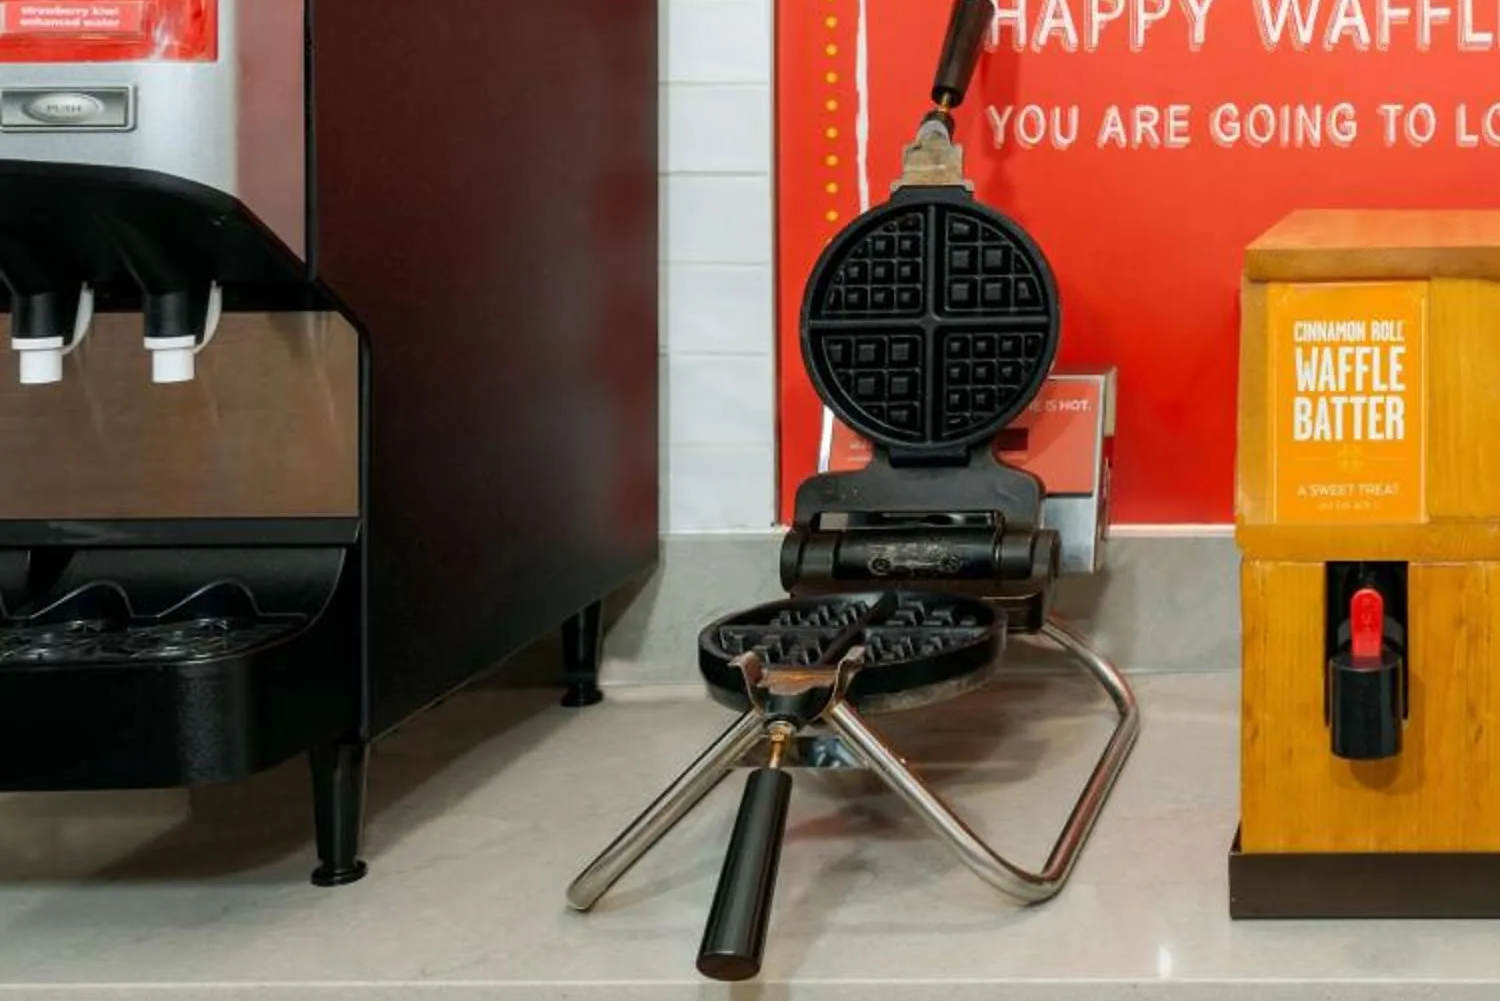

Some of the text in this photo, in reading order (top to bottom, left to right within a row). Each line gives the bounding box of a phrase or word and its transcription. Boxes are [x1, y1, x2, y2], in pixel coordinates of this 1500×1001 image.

[985, 104, 1079, 149] YOU
[1097, 104, 1191, 149] ARE
[1209, 102, 1358, 149] GOING
[1381, 102, 1437, 149] TO
[1294, 320, 1405, 342] CINNAMON ROLL
[1295, 346, 1406, 392] WAFFLE
[1045, 399, 1057, 412] IS
[1293, 395, 1405, 441] BATTER
[1297, 482, 1399, 497] A SWEET TREAT
